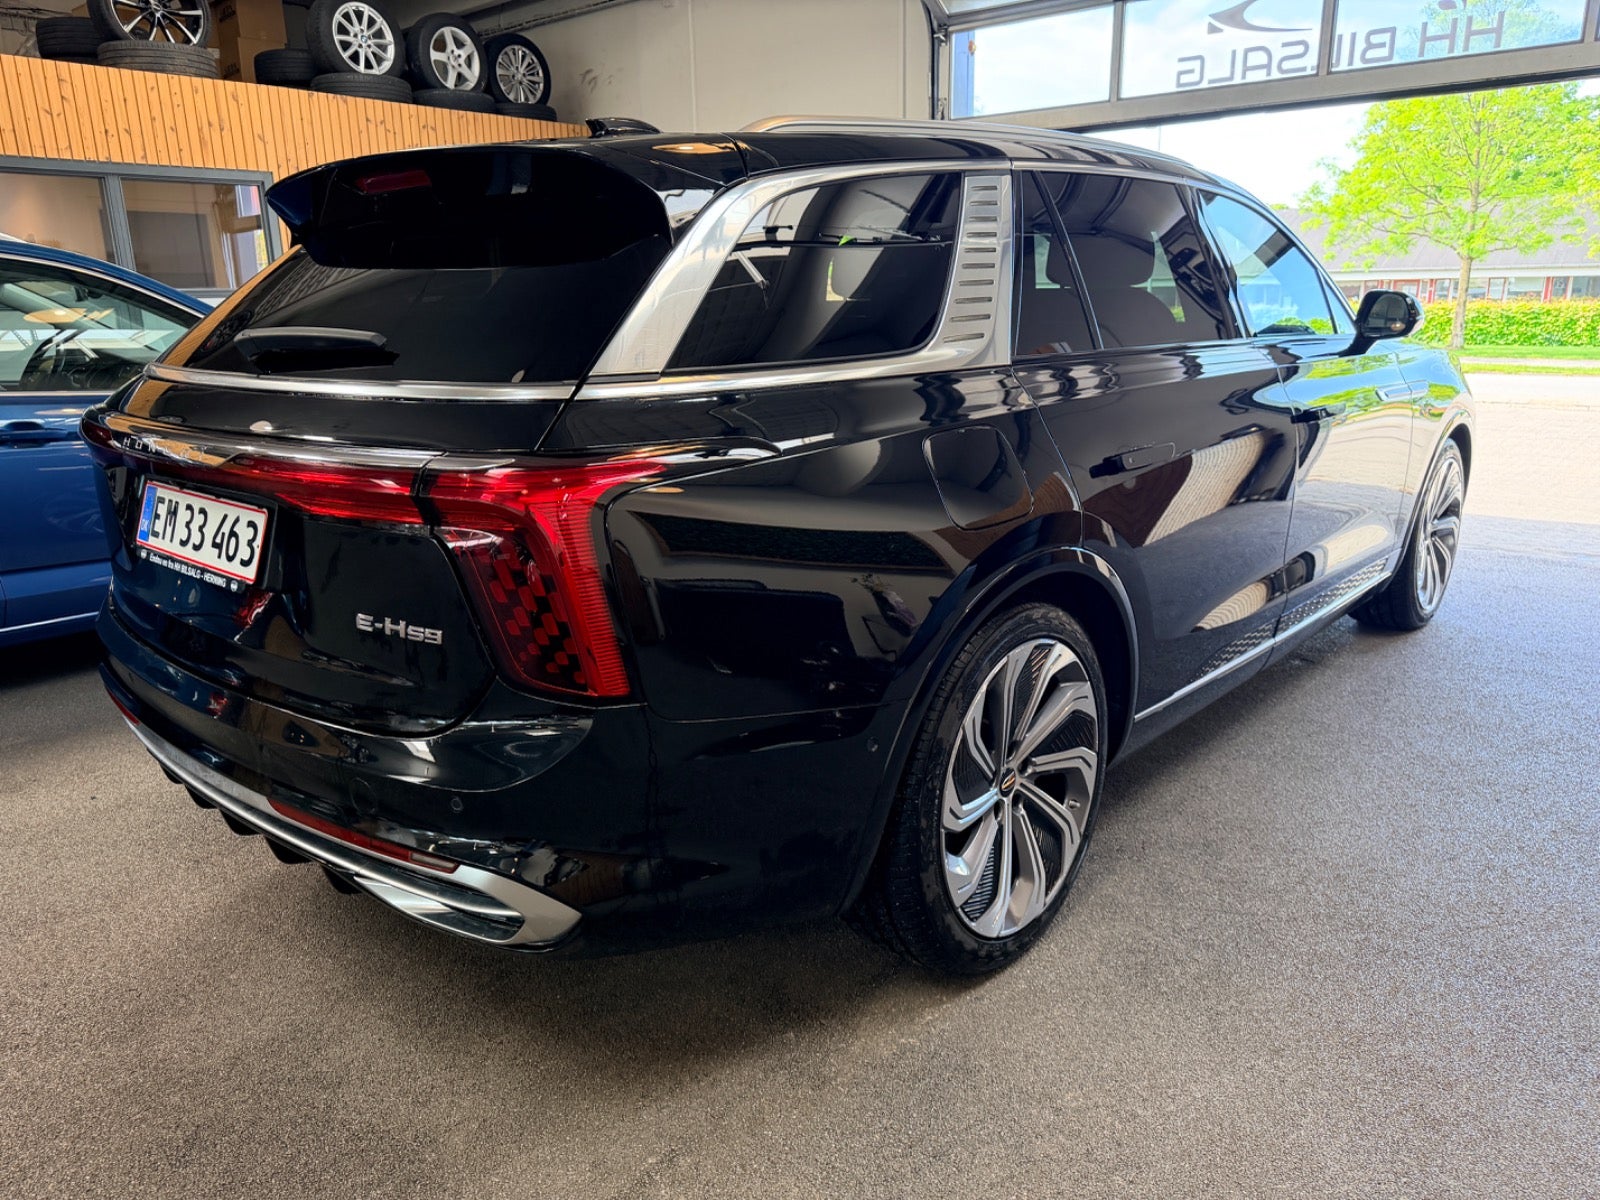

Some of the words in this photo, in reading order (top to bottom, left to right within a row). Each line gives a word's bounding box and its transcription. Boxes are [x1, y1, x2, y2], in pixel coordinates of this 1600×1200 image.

[151, 496, 179, 543] EM
[179, 503, 208, 552] 33
[211, 513, 258, 568] 463
